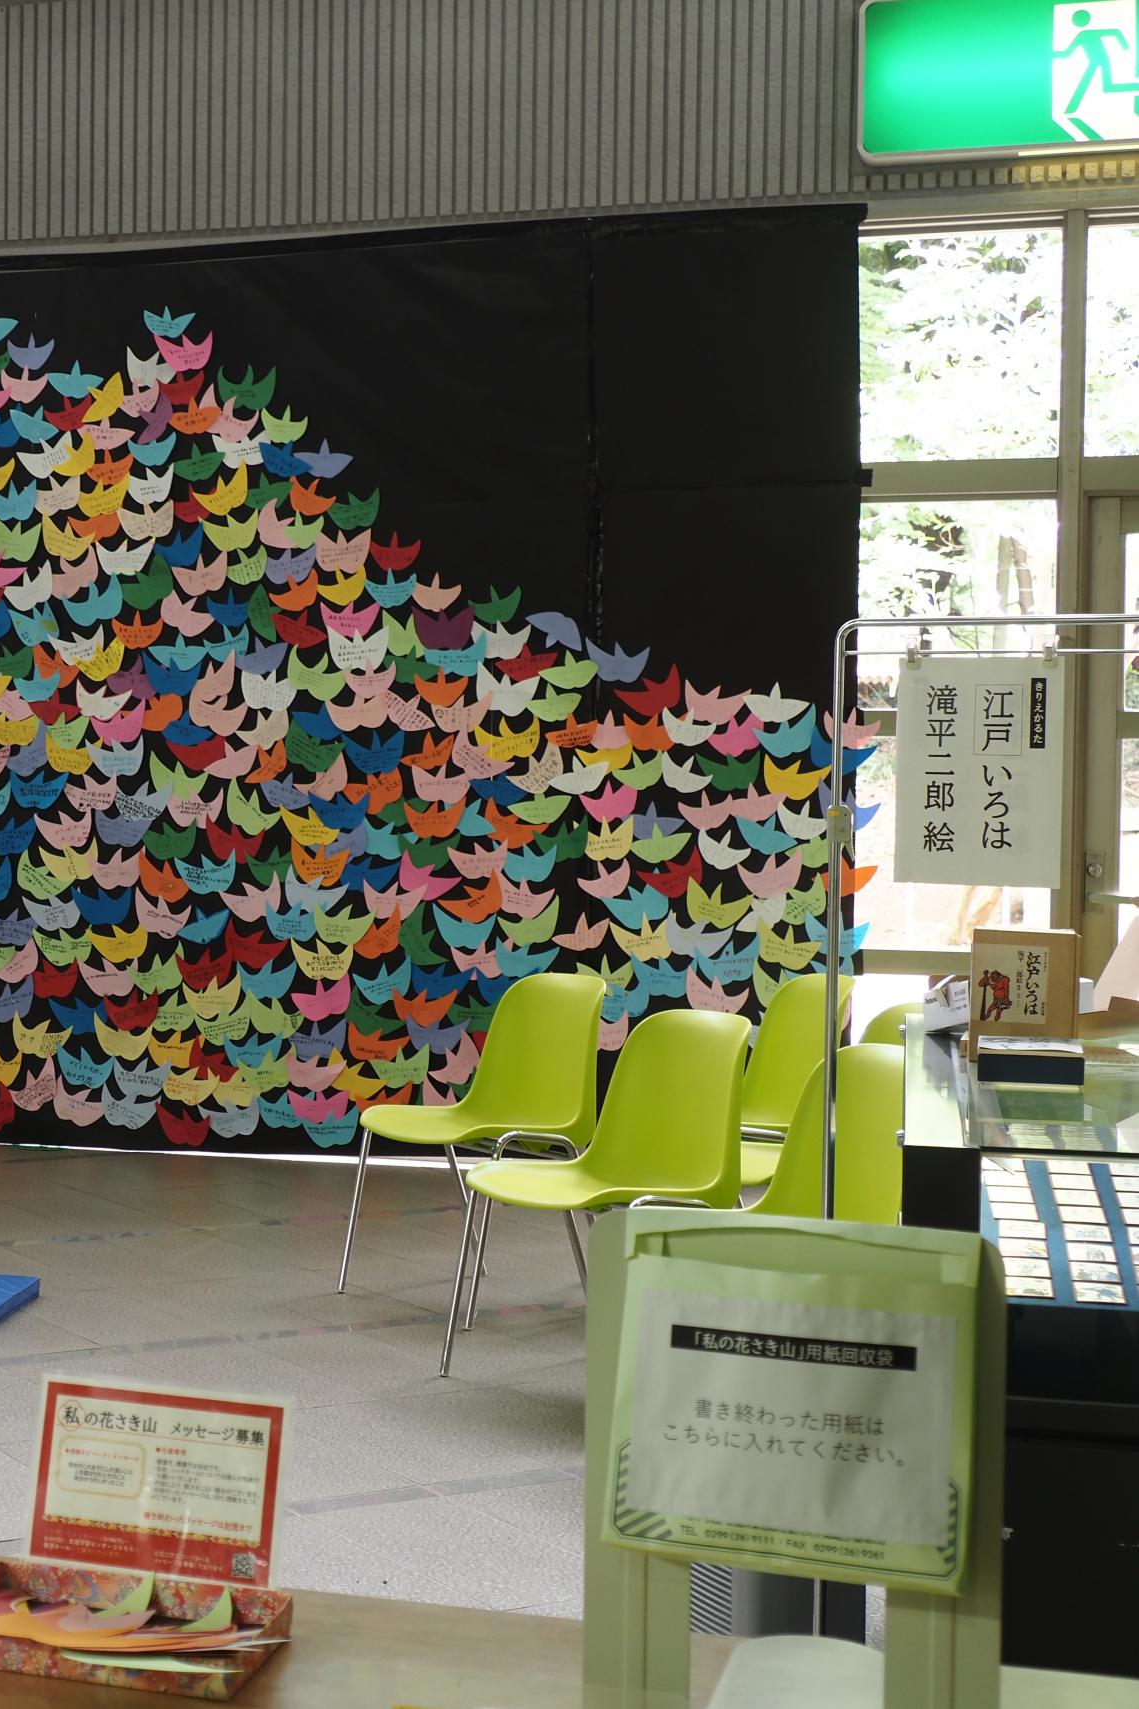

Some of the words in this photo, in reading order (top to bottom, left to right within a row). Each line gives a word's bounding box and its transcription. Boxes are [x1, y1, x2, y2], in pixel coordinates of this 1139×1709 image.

[1032, 681, 1045, 744] きりえかるた
[1024, 951, 1041, 1016] 江戸いろは
[693, 1331, 894, 1368] 「私の花さき山」用紙回収袋
[62, 1405, 158, 1434] 私の花さき山
[170, 1421, 265, 1447] メッセージ募集
[694, 1398, 885, 1437] 書き終わった用紙は
[663, 1423, 906, 1468] こちらに入れてください。
[680, 1525, 698, 1537] TEL
[785, 1539, 806, 1551] FAX
